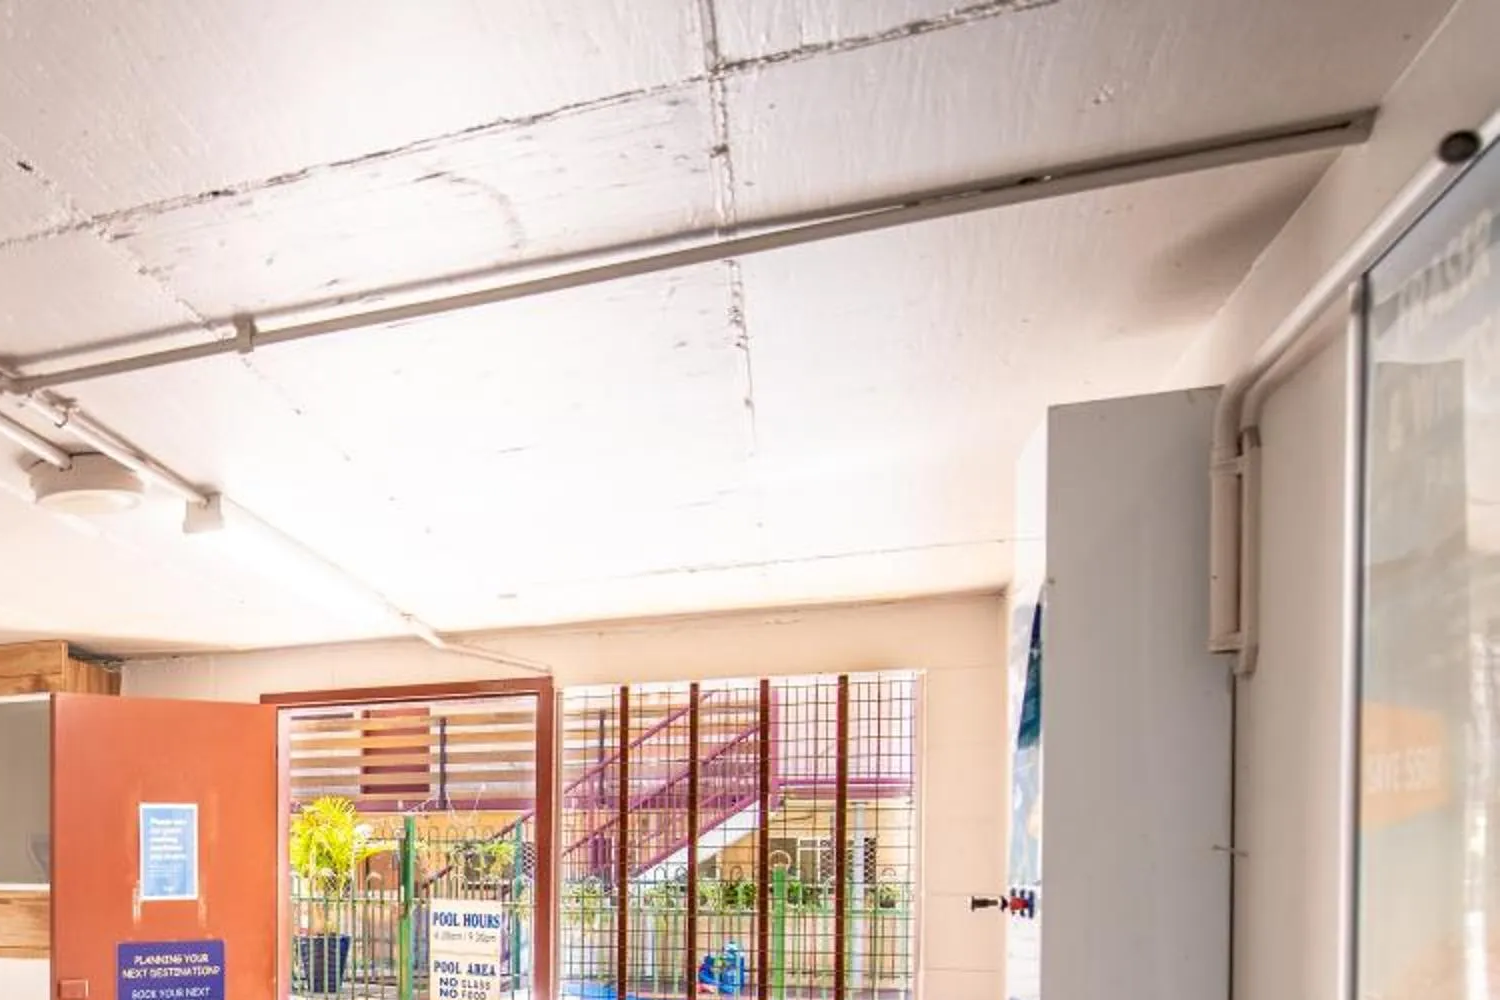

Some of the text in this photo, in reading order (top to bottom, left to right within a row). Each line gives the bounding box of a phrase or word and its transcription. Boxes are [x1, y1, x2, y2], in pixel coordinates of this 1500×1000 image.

[433, 911, 500, 929] POOL HOURS
[133, 952, 209, 966] PLANNING YOUR
[122, 968, 148, 979] NEXT
[433, 960, 497, 977] POOL AREA
[439, 977, 459, 988] NO
[159, 988, 184, 999] YOUR
[185, 986, 210, 998] NEXT
[439, 988, 459, 999] NO
